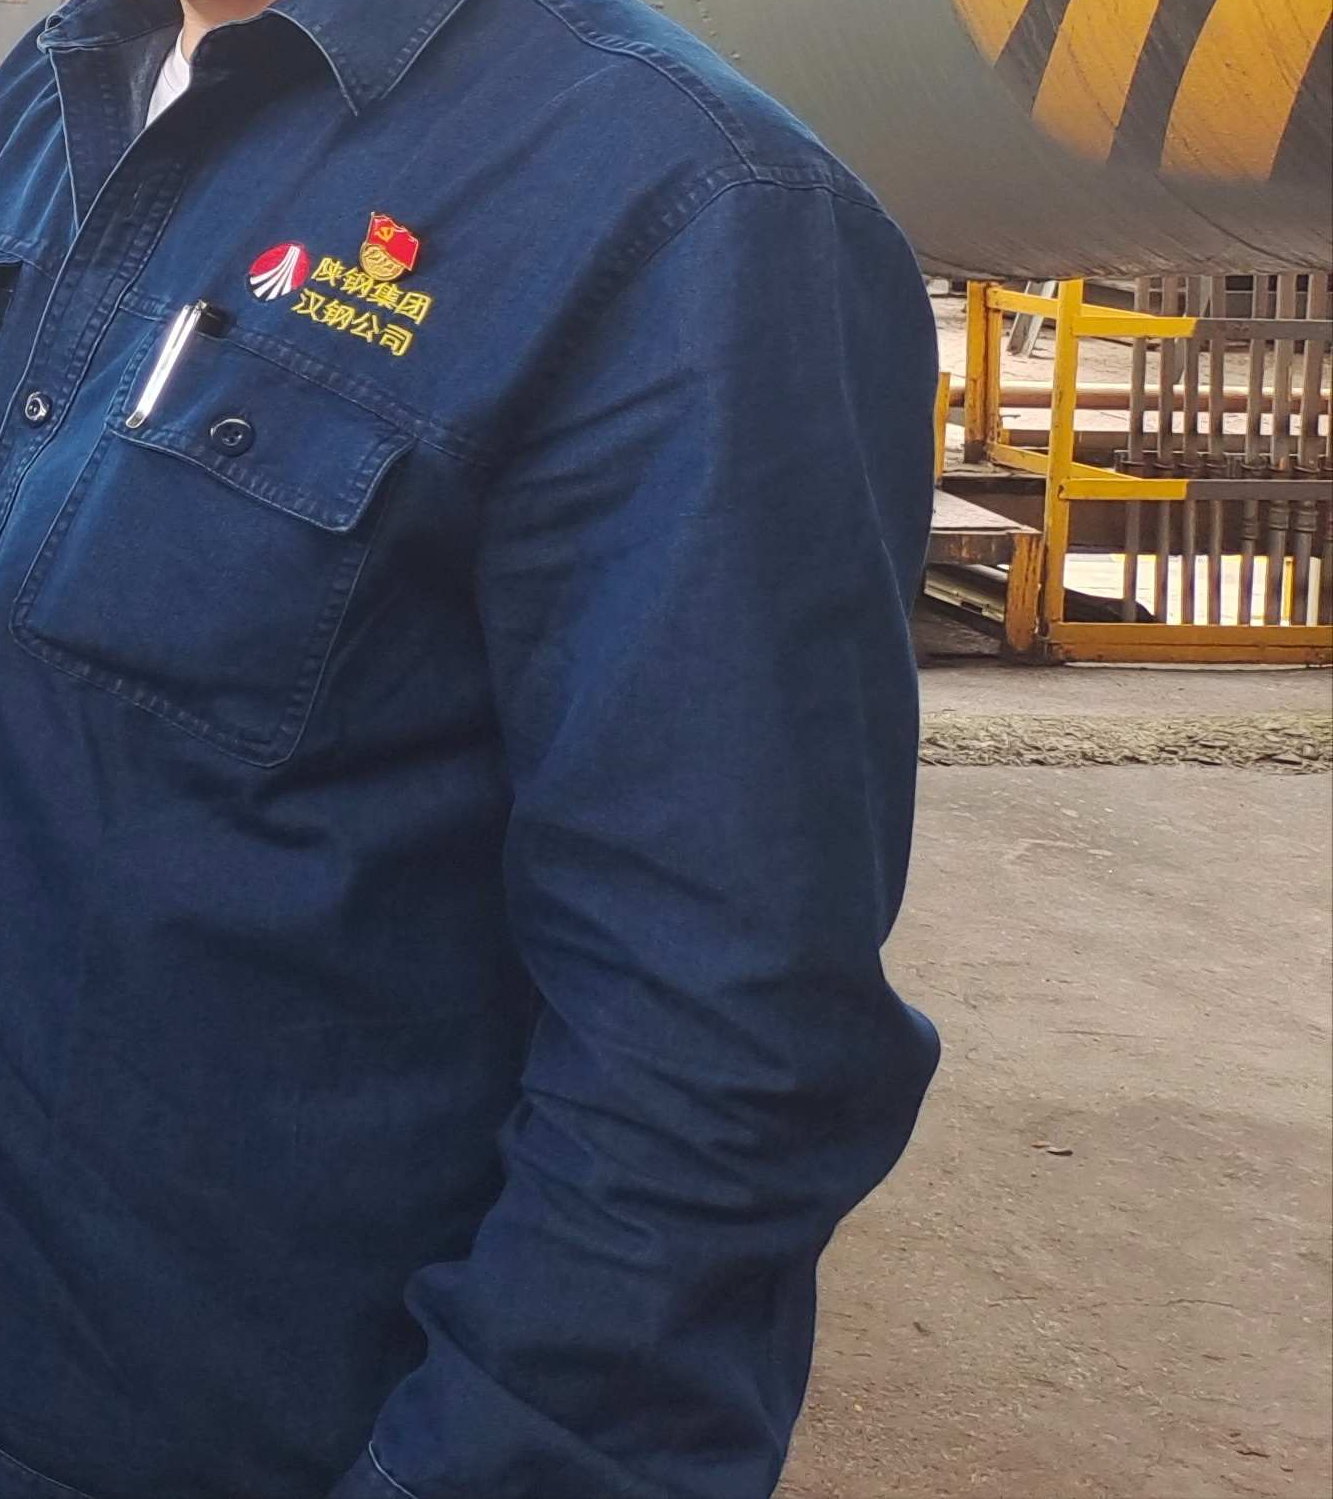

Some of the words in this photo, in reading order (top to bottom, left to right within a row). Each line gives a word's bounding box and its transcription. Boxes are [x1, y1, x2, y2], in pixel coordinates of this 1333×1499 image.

[291, 287, 417, 357] 汉钢公司
[310, 256, 434, 325] 陕钢集团
